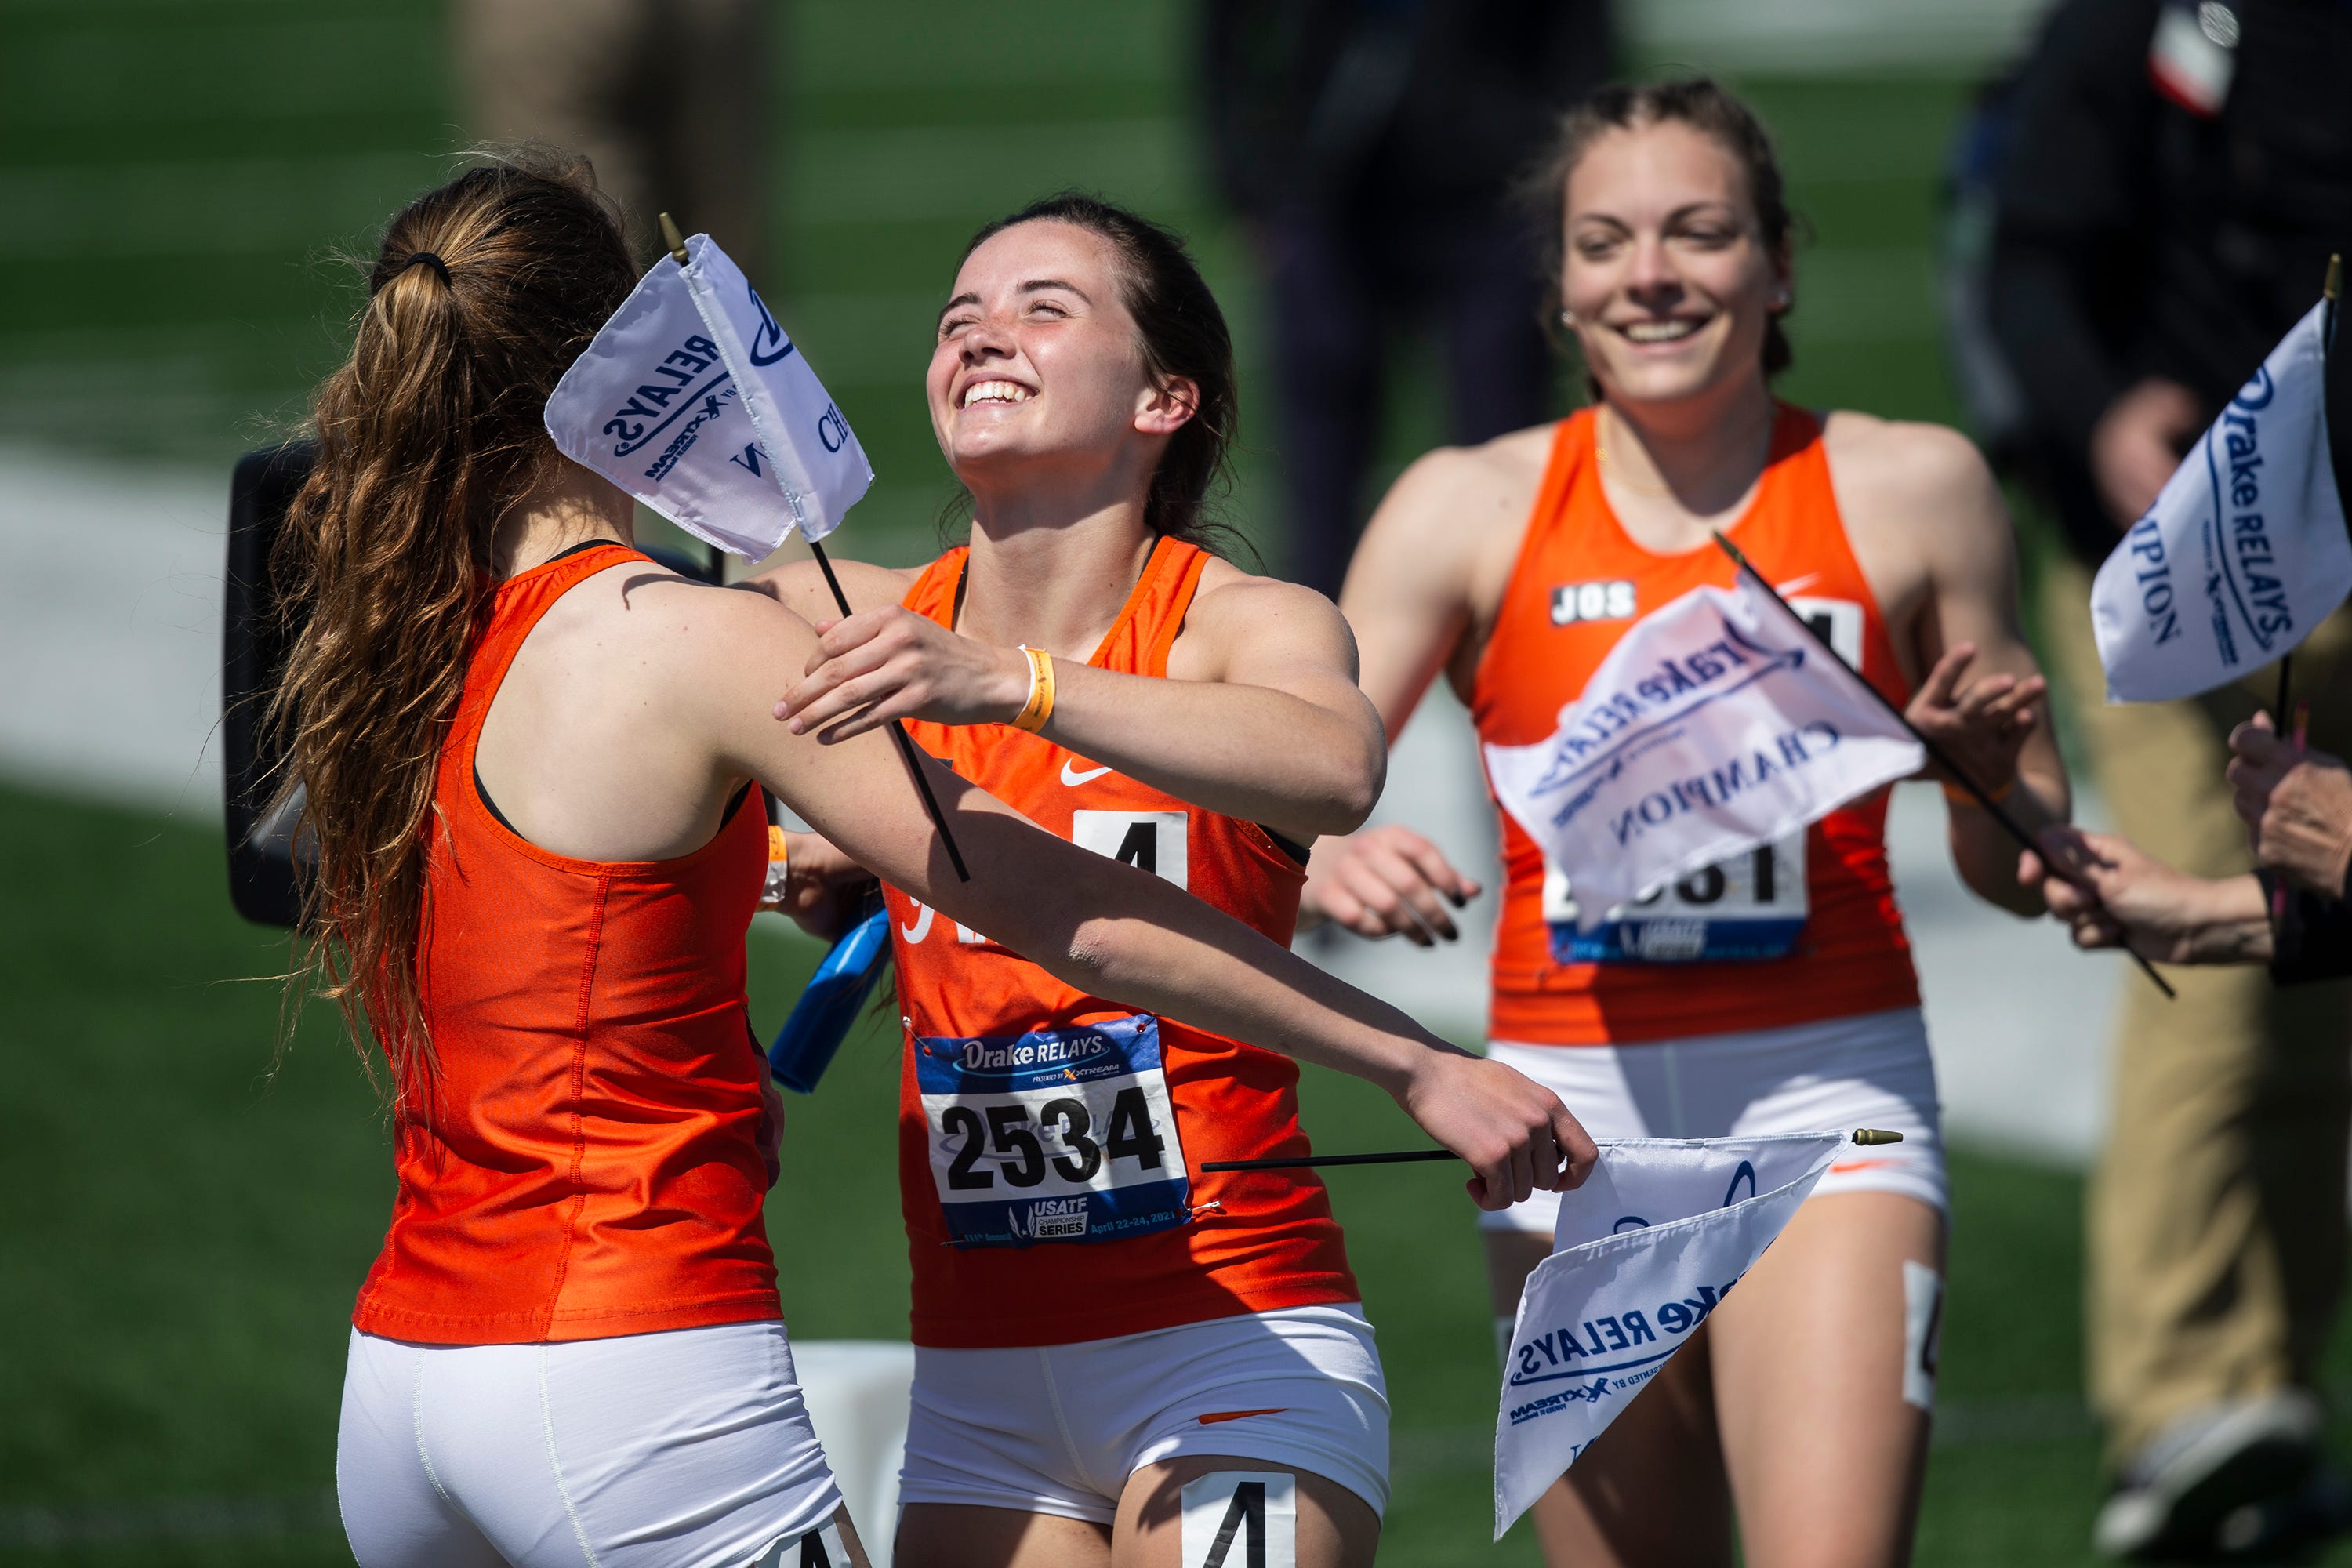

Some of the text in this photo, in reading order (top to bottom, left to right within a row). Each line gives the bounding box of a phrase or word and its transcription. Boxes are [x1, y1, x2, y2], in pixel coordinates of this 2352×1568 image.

[2234, 512, 2292, 633] RELAYS
[1552, 580, 1635, 626] JOS
[963, 1036, 1103, 1069] Drake RELAYS
[1033, 1074, 1057, 1083] PRESENTED
[1076, 1064, 1120, 1076] XTREAM
[942, 1086, 1165, 1190] 2534
[1034, 1197, 1087, 1216] USATF
[1038, 1215, 1085, 1225] CHAMPIONSHIP
[1040, 1221, 1083, 1236] SERIES
[1091, 1210, 1175, 1235] April 22-24, 2021
